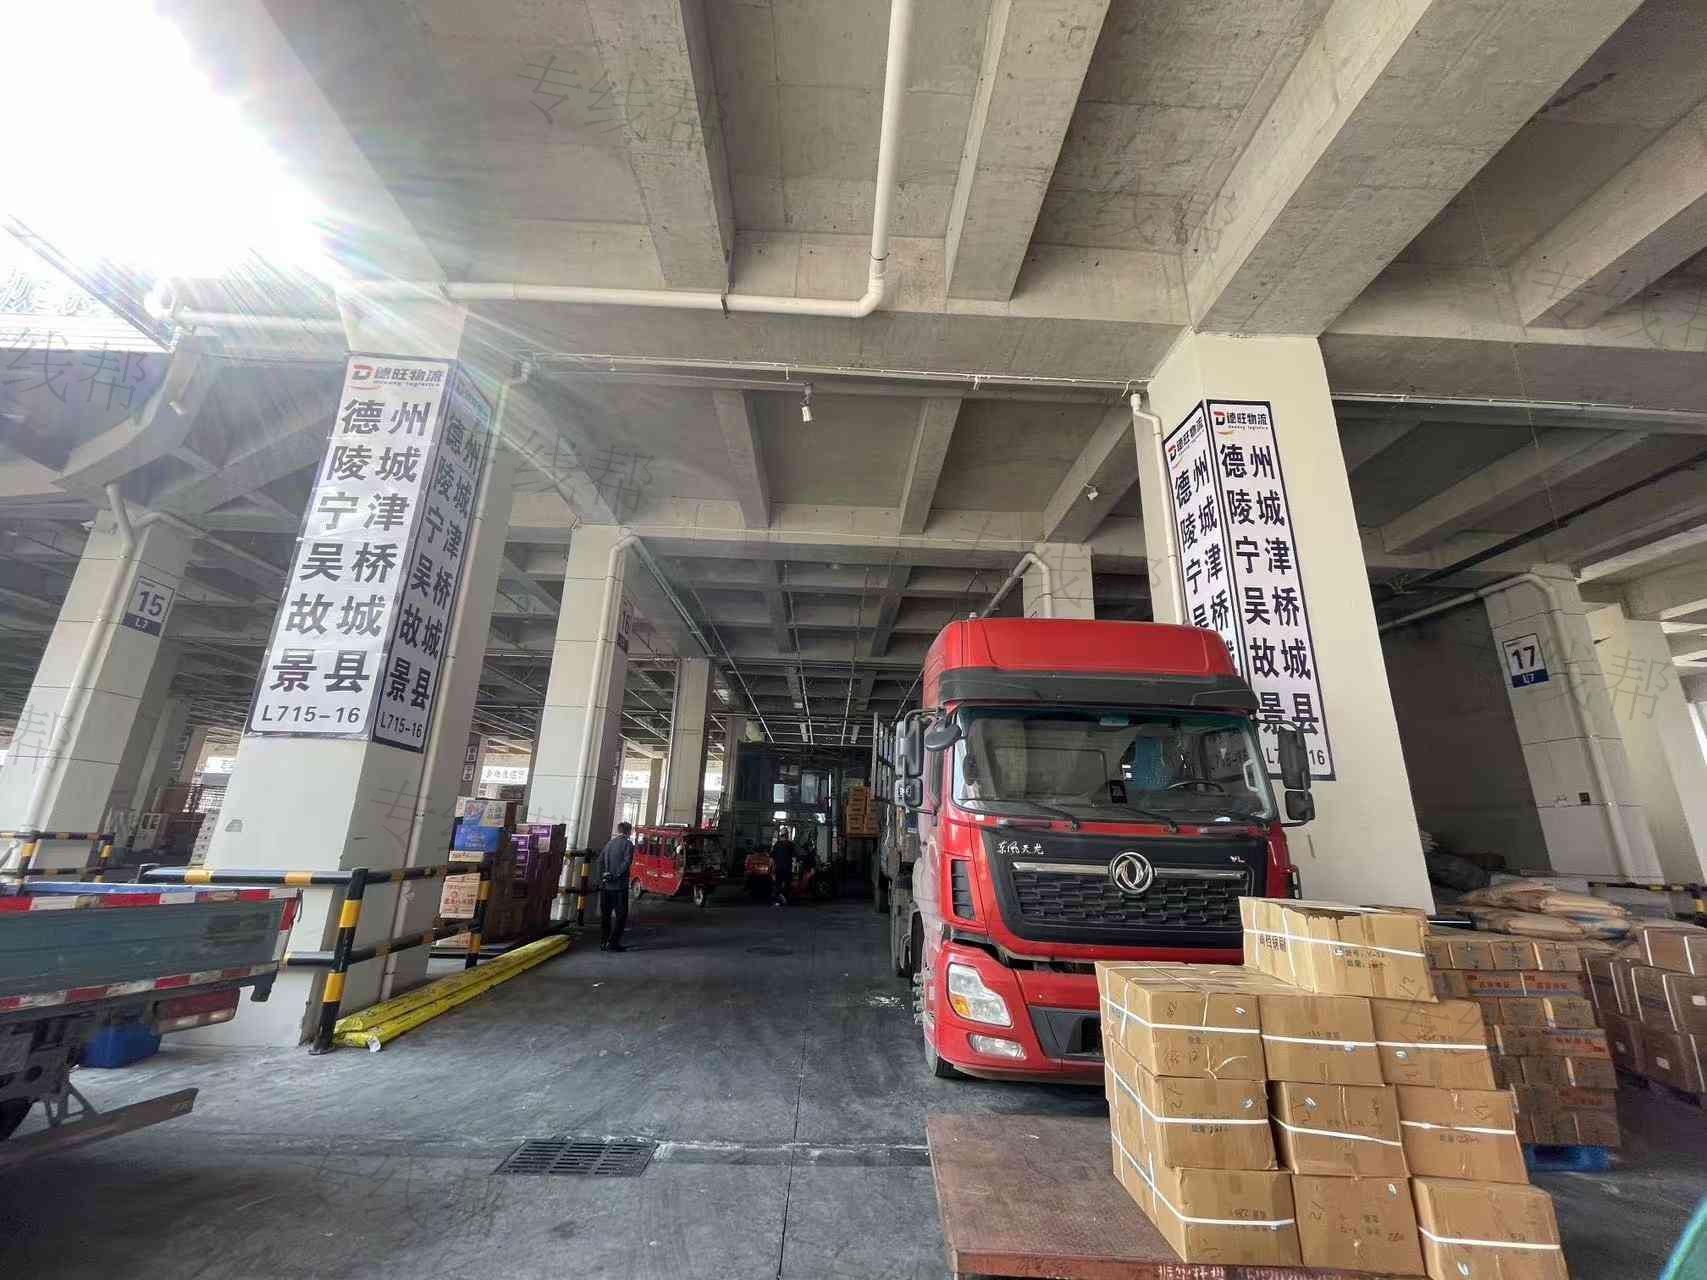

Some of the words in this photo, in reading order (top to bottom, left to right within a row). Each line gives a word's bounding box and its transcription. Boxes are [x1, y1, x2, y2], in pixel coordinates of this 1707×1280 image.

[341, 399, 432, 436] 德州
[1226, 412, 1268, 425] 德旺物流
[326, 444, 422, 483] 陵城
[1174, 450, 1210, 508] 德州
[1220, 443, 1276, 479] 德州
[317, 491, 410, 531] 宁津
[1180, 495, 1218, 552] 陵城
[1226, 489, 1286, 526] 陵城
[425, 504, 463, 560] 宁津
[299, 542, 398, 583] 吴桥
[1186, 543, 1224, 595] 宁津
[1235, 536, 1293, 575] 宁津
[411, 552, 454, 610] 吴桥
[139, 591, 165, 616] 15
[285, 593, 385, 637] 故城
[1244, 586, 1300, 627] 吴桥
[400, 603, 443, 659] 故城
[270, 648, 369, 693] 景县
[1250, 637, 1312, 680] 故城
[1512, 645, 1535, 669] 17
[386, 656, 432, 711] 景县
[262, 705, 361, 723] L715-16
[379, 711, 423, 738] L715-16
[1259, 692, 1319, 735] 景县
